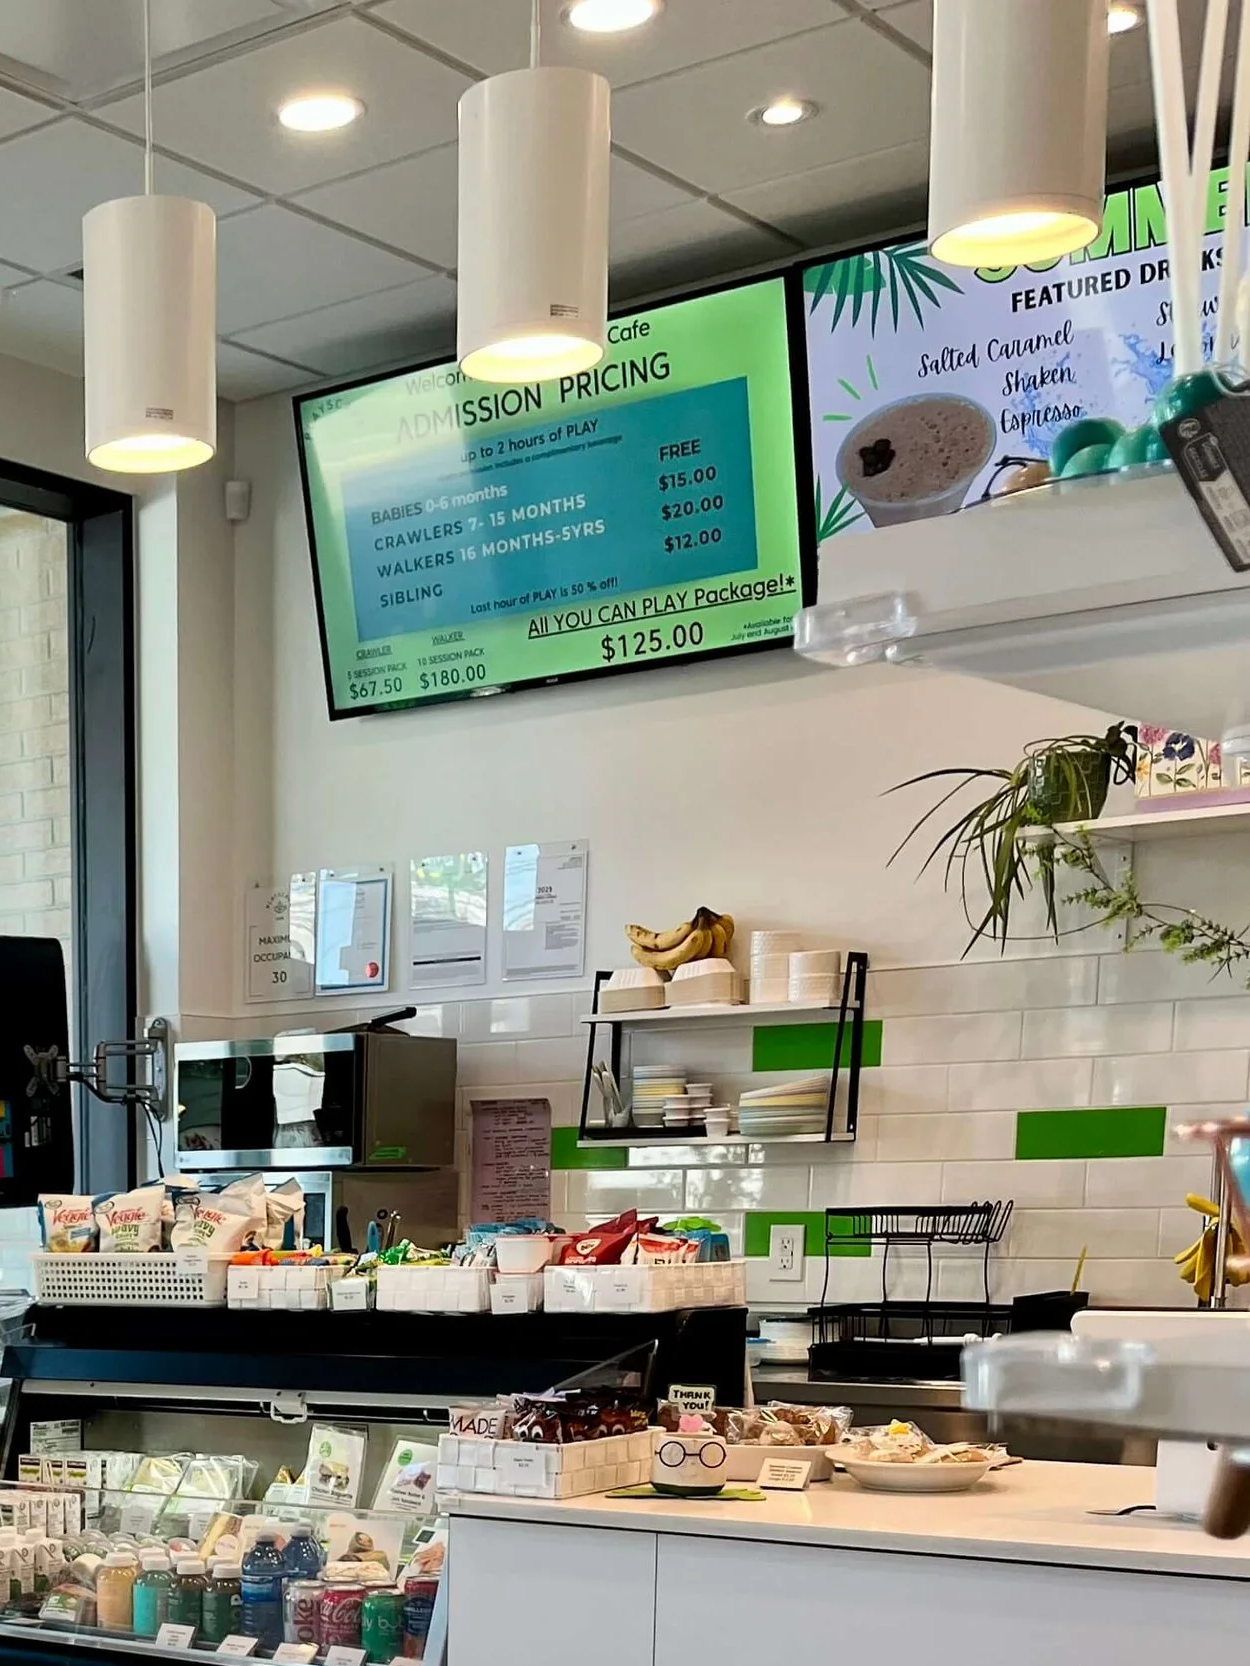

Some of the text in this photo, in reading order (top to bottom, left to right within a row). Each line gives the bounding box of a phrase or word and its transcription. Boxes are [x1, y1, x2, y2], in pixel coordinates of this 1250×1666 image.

[1011, 268, 1131, 313] FEATURED
[1140, 247, 1225, 284] DRKS
[607, 320, 651, 345] Cafe
[918, 319, 1075, 378] Salted Caramel
[396, 351, 671, 444] ADMISSION PRICING
[1001, 364, 1077, 398] Shaken
[1000, 404, 1083, 436] Espresso
[480, 445, 494, 460] to
[497, 440, 506, 454] 2
[509, 429, 546, 452] hours
[549, 425, 562, 443] of
[566, 418, 599, 439] PLAY
[371, 438, 702, 526] BABIES 0-6 months FREE
[374, 520, 464, 552] CRAWLERS
[489, 511, 506, 528] 15
[511, 493, 587, 523] MONTHS
[658, 465, 718, 492] $15.00
[377, 494, 724, 579] WALKERS 16 MONTHS-5YRS $20.00
[379, 527, 723, 609] SIBLING $12.00
[470, 603, 492, 615] Last
[494, 594, 517, 610] hour
[519, 593, 530, 605] of
[532, 586, 557, 604] PLAY
[560, 586, 569, 598] is
[571, 583, 584, 597] 50
[586, 581, 597, 592] %
[528, 608, 549, 637] All
[553, 610, 593, 631] YOU
[597, 600, 637, 624] CAN
[641, 589, 689, 616] PLAY
[431, 630, 464, 645] WALKER
[601, 621, 704, 663] $125.00
[429, 650, 463, 667] SESSION
[464, 646, 486, 660] PACK
[349, 662, 487, 701] $67.50 $180.00
[253, 951, 291, 963] OCCUPA
[258, 934, 291, 946] MAXIM
[271, 970, 288, 984] 30
[673, 1389, 712, 1401] THANK
[682, 1400, 710, 1411] YOU!
[450, 1414, 498, 1436] MADE
[294, 1598, 315, 1640] oke
